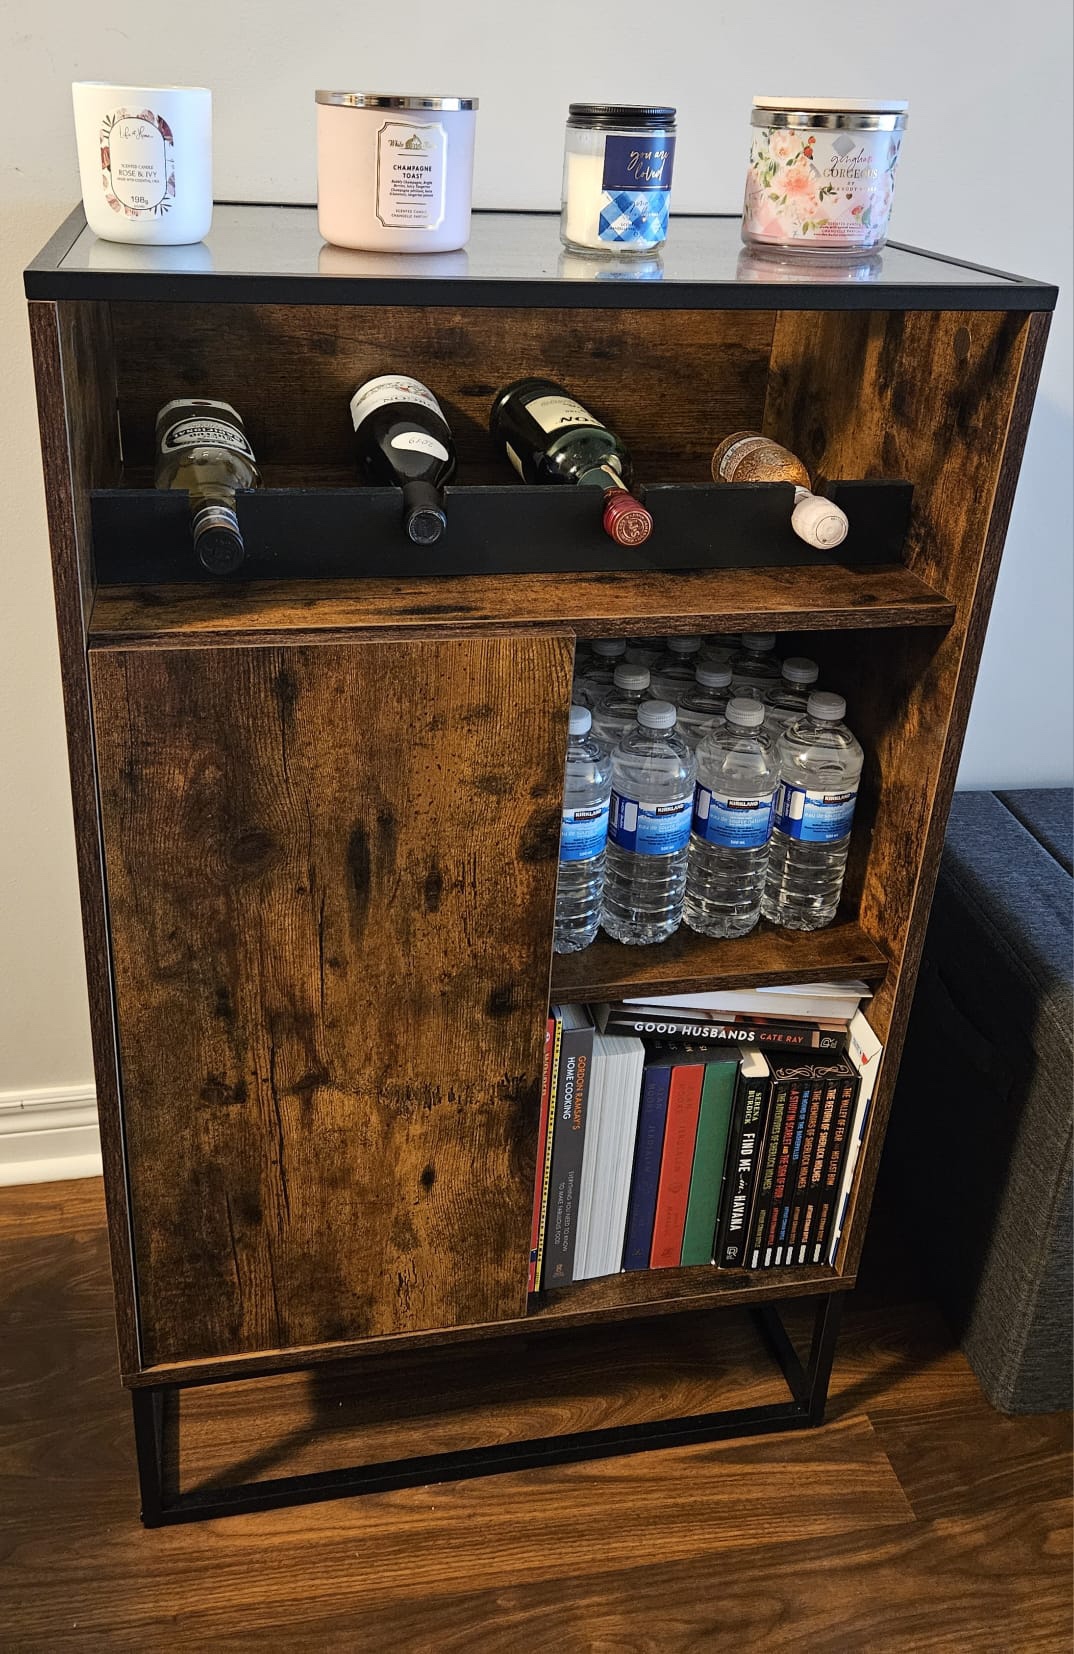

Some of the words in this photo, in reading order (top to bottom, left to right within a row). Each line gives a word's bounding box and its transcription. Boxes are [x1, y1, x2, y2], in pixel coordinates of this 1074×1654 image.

[657, 804, 684, 812] KIRKLAND
[634, 1022, 677, 1034] GOOD
[682, 1025, 756, 1042] HUSBANDS
[786, 1035, 804, 1043] RAY
[566, 1056, 575, 1080] HOME
[576, 1055, 586, 1090] GORDON
[563, 1082, 573, 1119] COOKING
[812, 1089, 821, 1102] THE
[826, 1087, 836, 1100] THE
[842, 1086, 851, 1098] THE
[573, 1092, 582, 1130] RAMSAY'S
[744, 1090, 756, 1124] BURDICK
[752, 1092, 762, 1121] SERENA
[788, 1095, 798, 1113] STUDY
[822, 1099, 833, 1123] RETURN
[839, 1098, 849, 1118] VALLEY
[783, 1121, 794, 1145] SCARLET
[821, 1122, 829, 1131] OF
[837, 1118, 845, 1126] OF
[740, 1133, 756, 1156] FIND
[816, 1131, 827, 1159] SHERLOCK
[834, 1126, 844, 1142] FEAR
[766, 1141, 778, 1168] SHERLOCK
[780, 1153, 788, 1164] THE
[801, 1136, 813, 1166] SHERLOCK
[738, 1158, 750, 1172] ME
[798, 1165, 808, 1188] HOLMES
[811, 1158, 823, 1182] HOLMES
[829, 1159, 837, 1172] LAST
[730, 1195, 746, 1231] HAVANA
